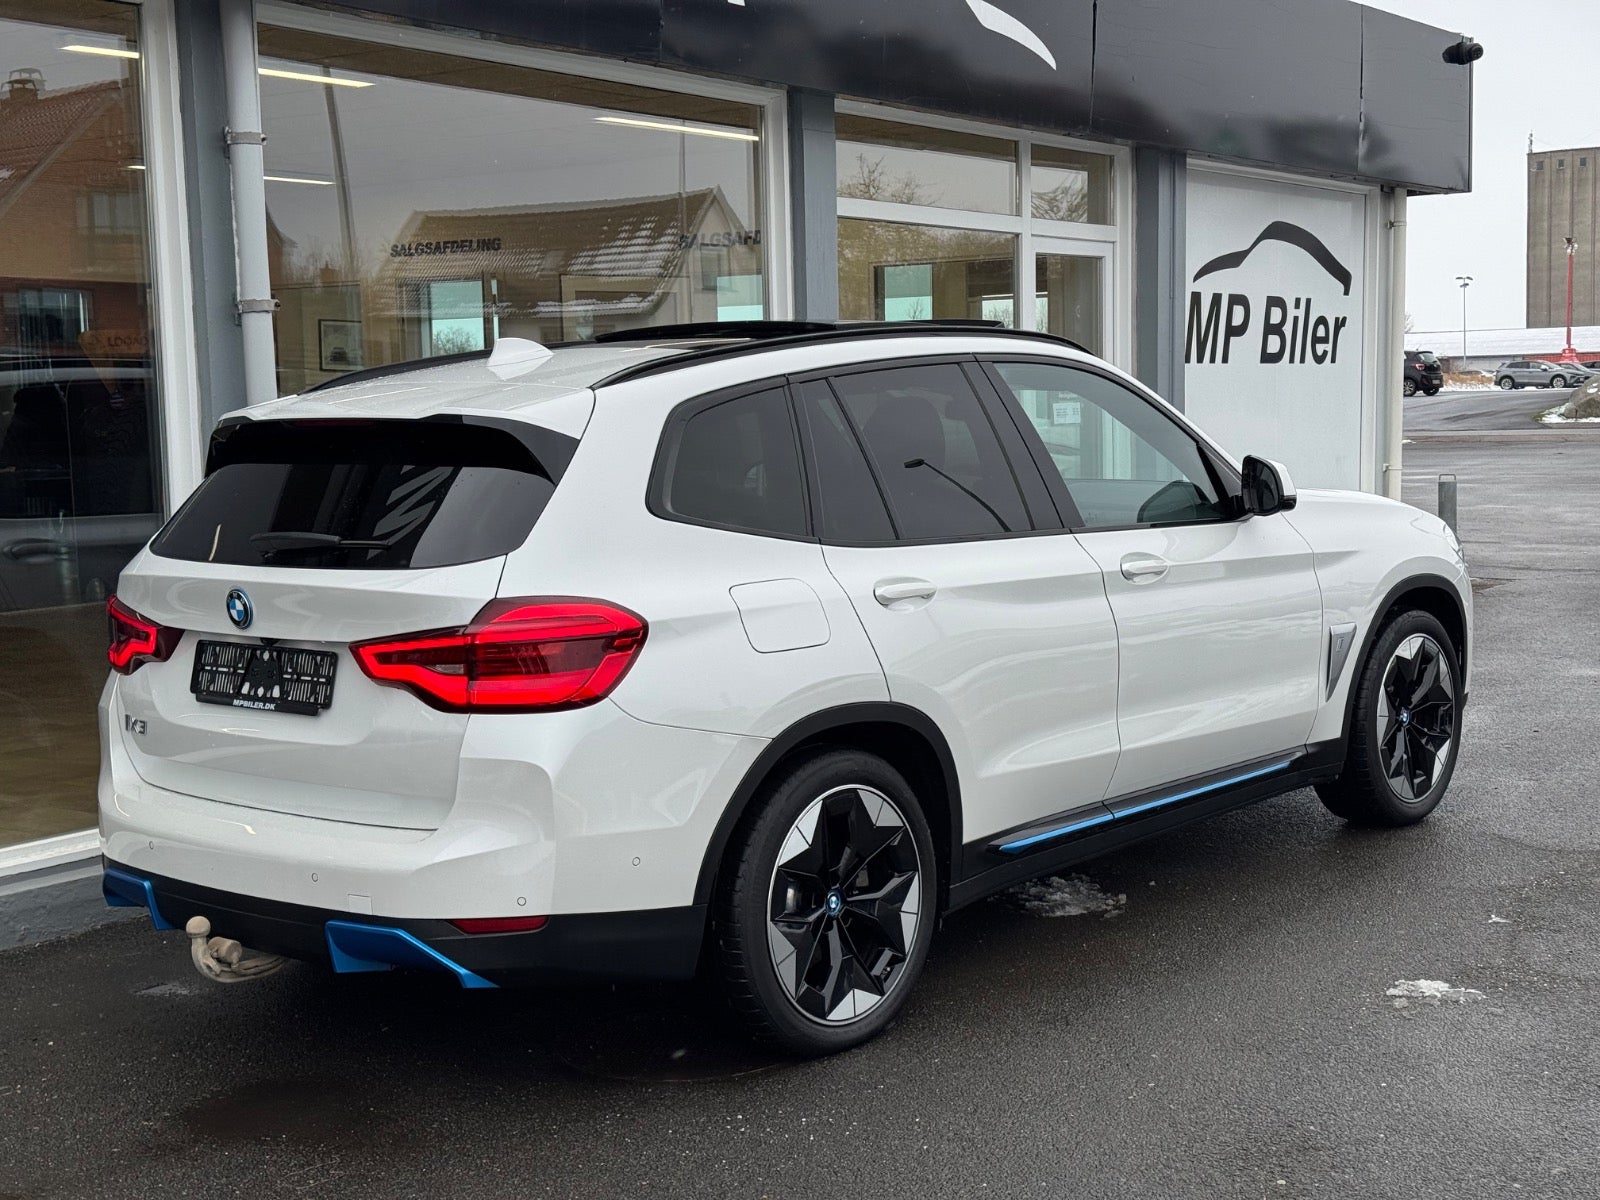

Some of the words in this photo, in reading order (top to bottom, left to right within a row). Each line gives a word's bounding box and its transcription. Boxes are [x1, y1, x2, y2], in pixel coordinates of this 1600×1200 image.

[390, 238, 502, 258] SALGSAFDELING
[1184, 291, 1251, 364] MP
[1259, 295, 1348, 365] Biler
[232, 698, 277, 711] MPBILER.DK
